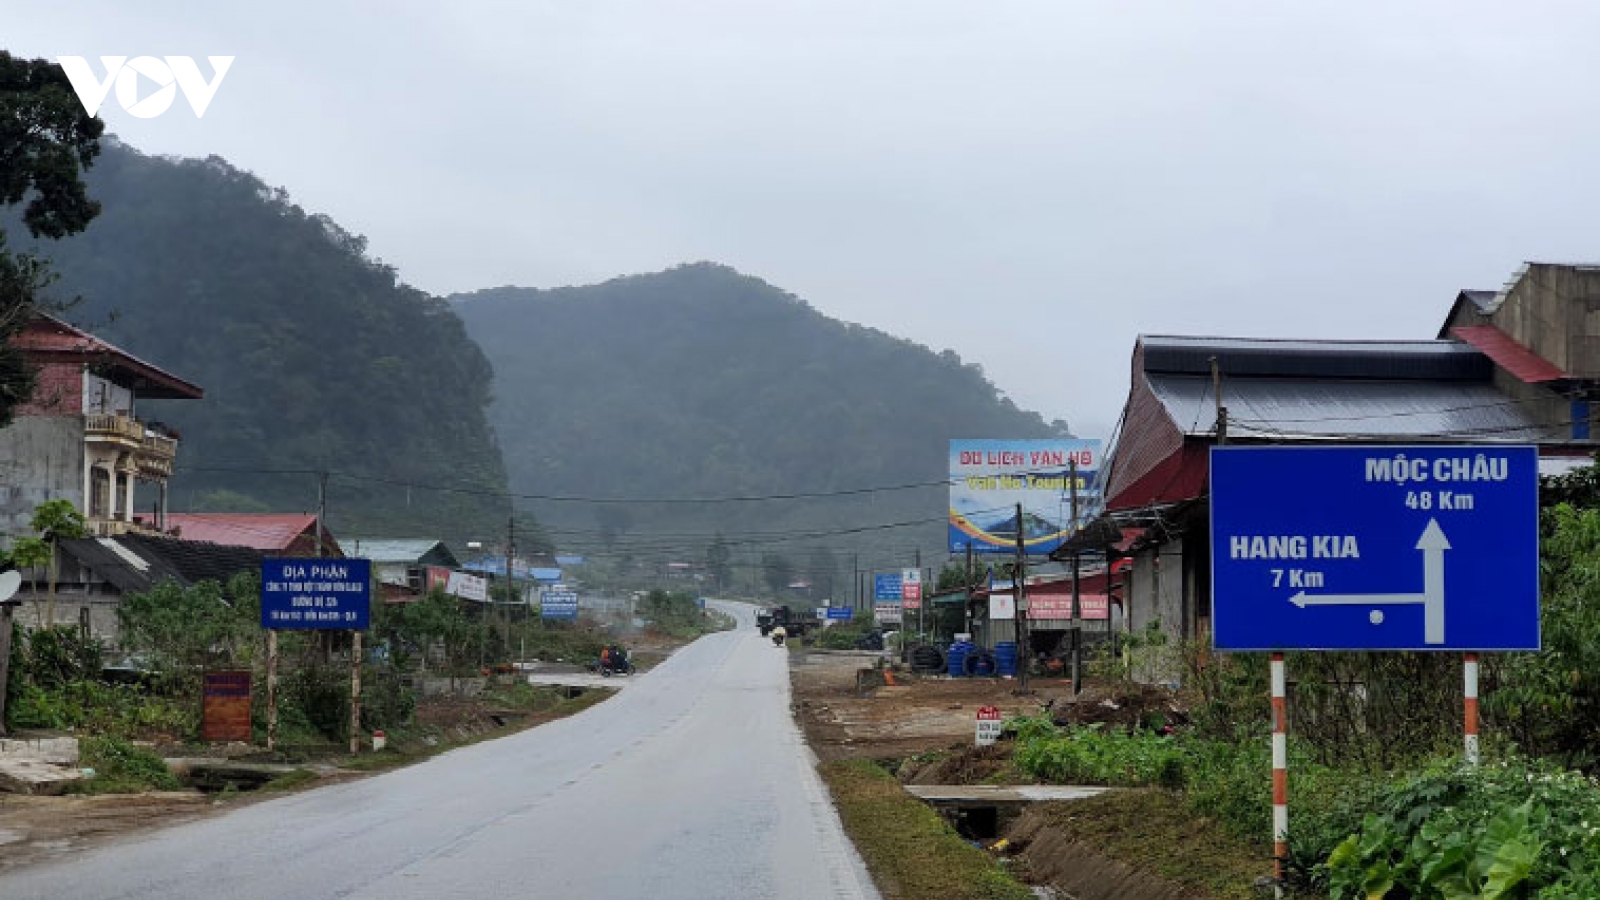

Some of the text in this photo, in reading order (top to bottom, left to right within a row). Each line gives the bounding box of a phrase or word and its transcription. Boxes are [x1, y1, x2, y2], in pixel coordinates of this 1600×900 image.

[960, 451, 983, 465] DU
[987, 451, 1024, 468] LỊCH
[1365, 453, 1508, 486] MỘC CHÂU
[967, 475, 997, 490] Van
[1405, 491, 1474, 510] 48 Km
[1230, 536, 1360, 559] HANG KIA
[1271, 570, 1324, 588] 7 Km
